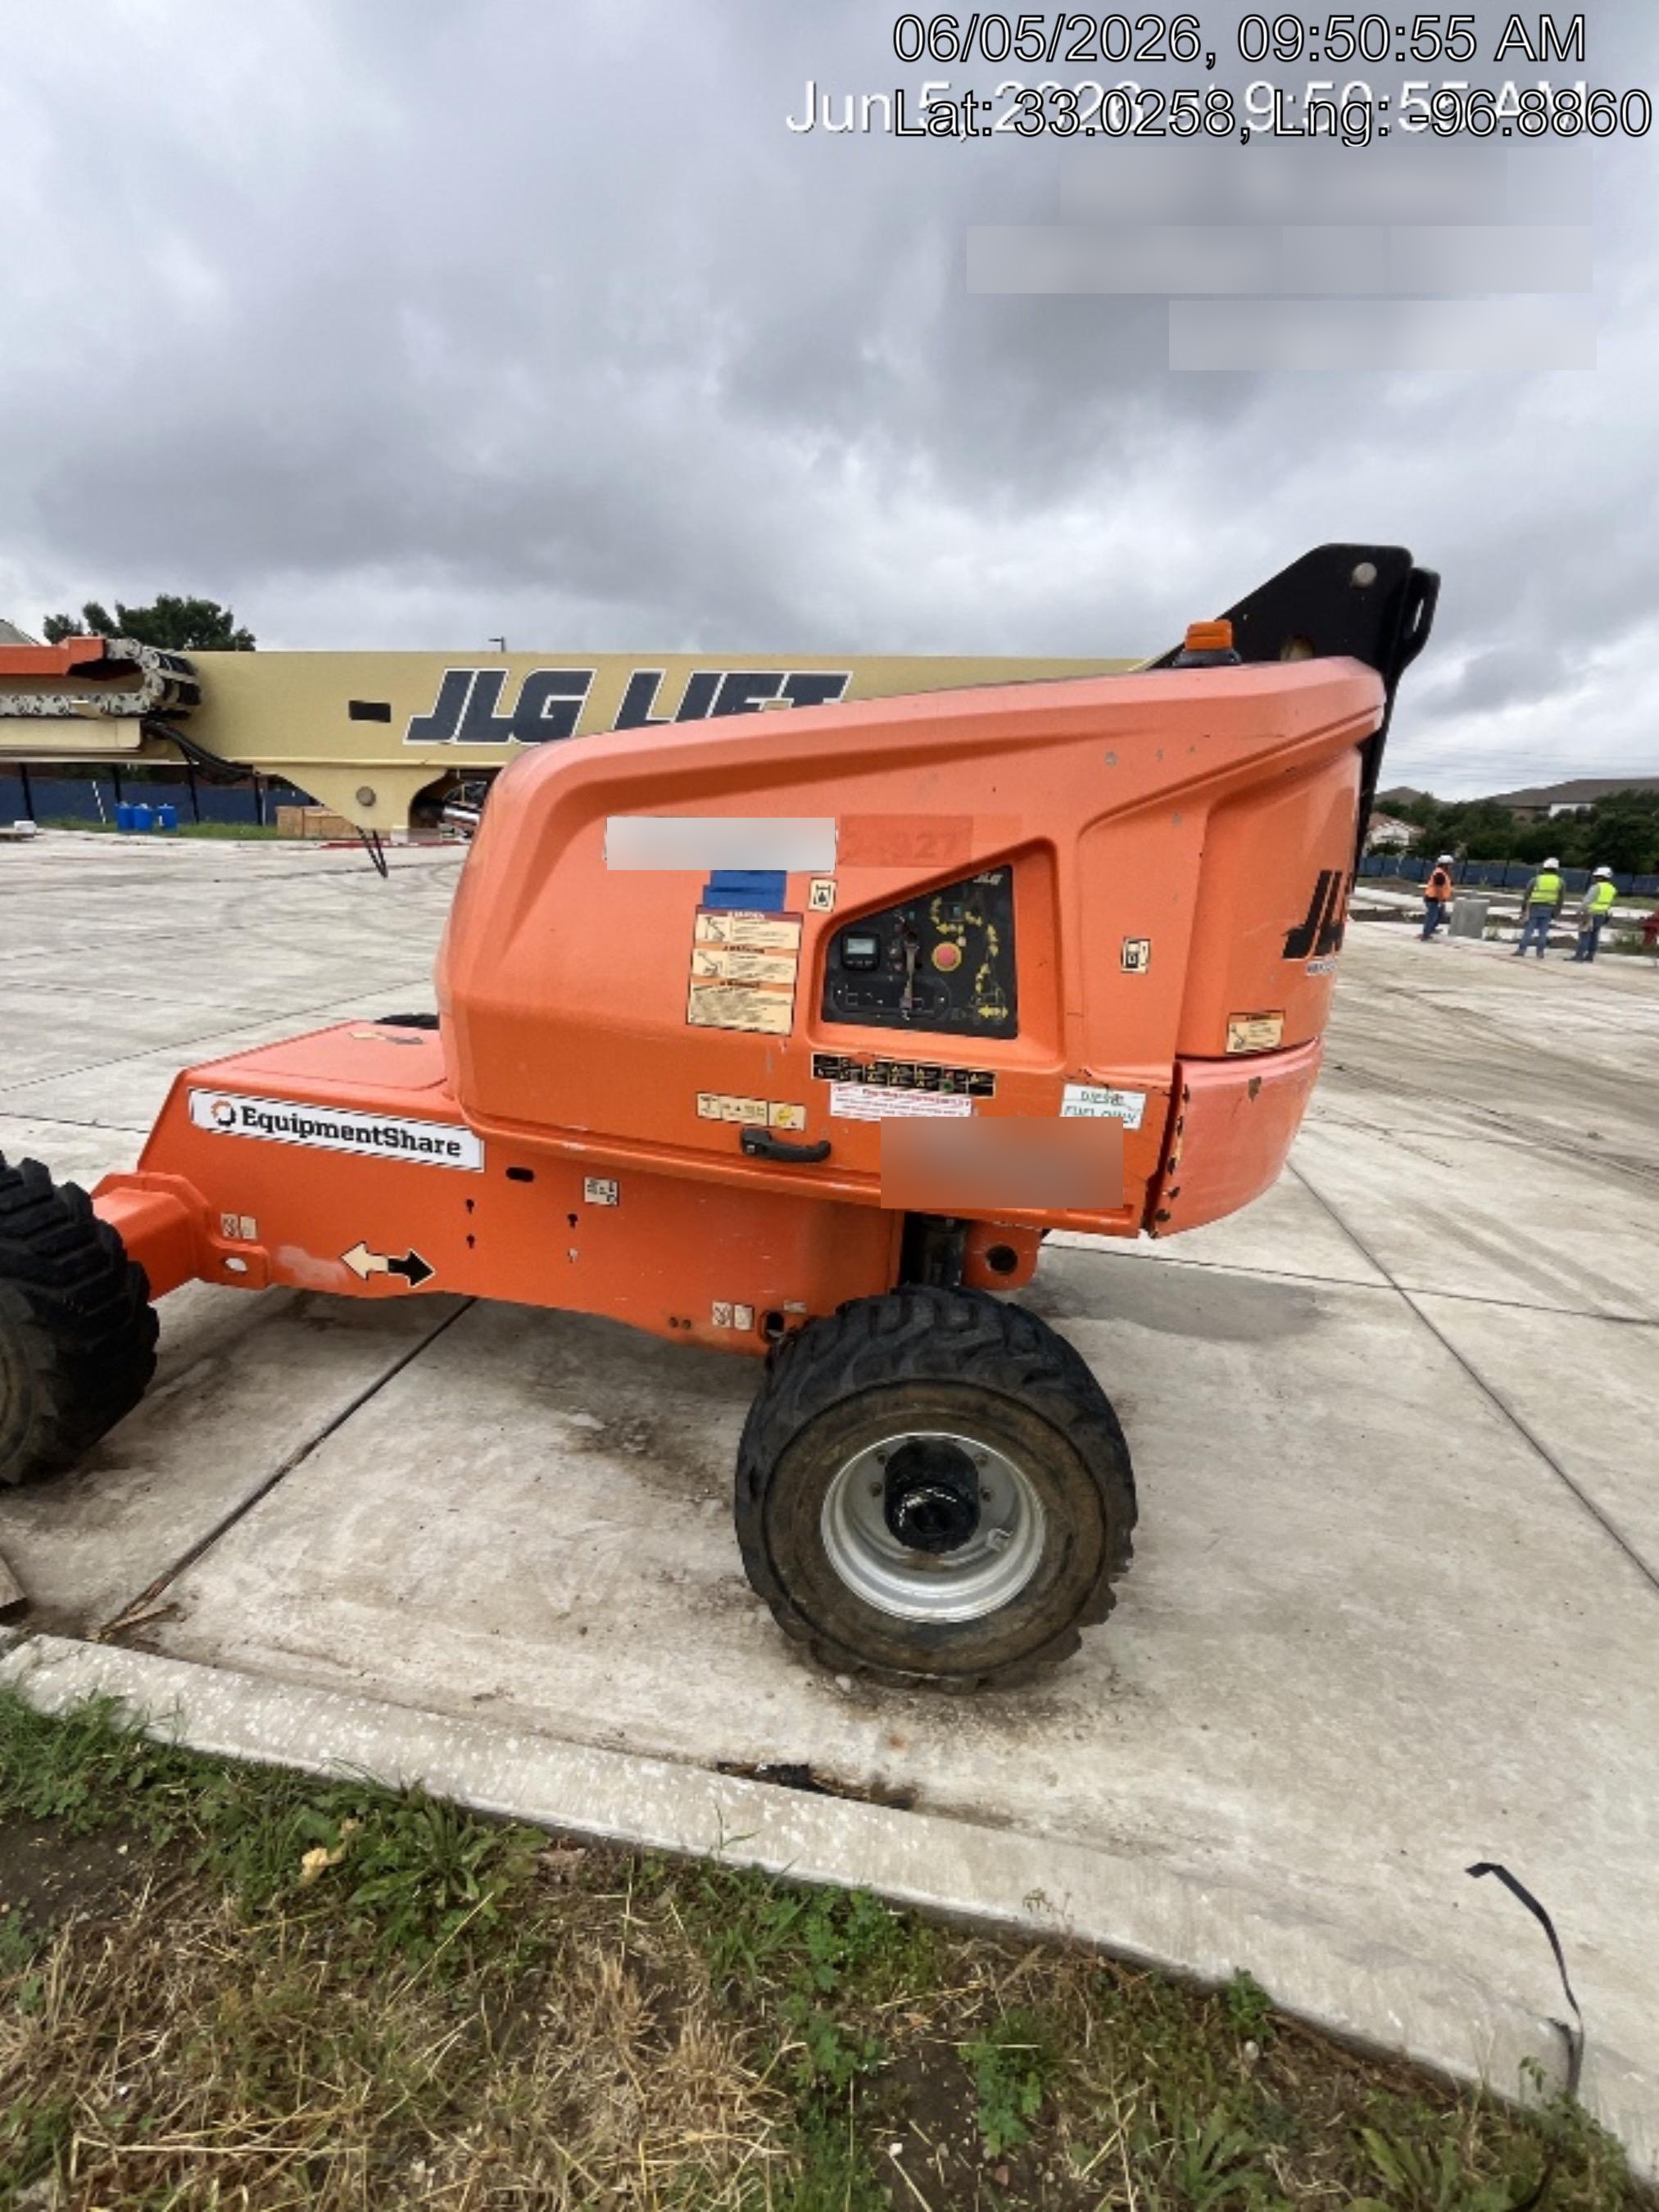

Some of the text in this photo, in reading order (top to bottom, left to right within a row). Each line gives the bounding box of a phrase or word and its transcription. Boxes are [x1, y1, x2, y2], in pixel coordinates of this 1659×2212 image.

[403, 669, 853, 745] JLG LIFT
[240, 1105, 462, 1158] EquipmentShare
